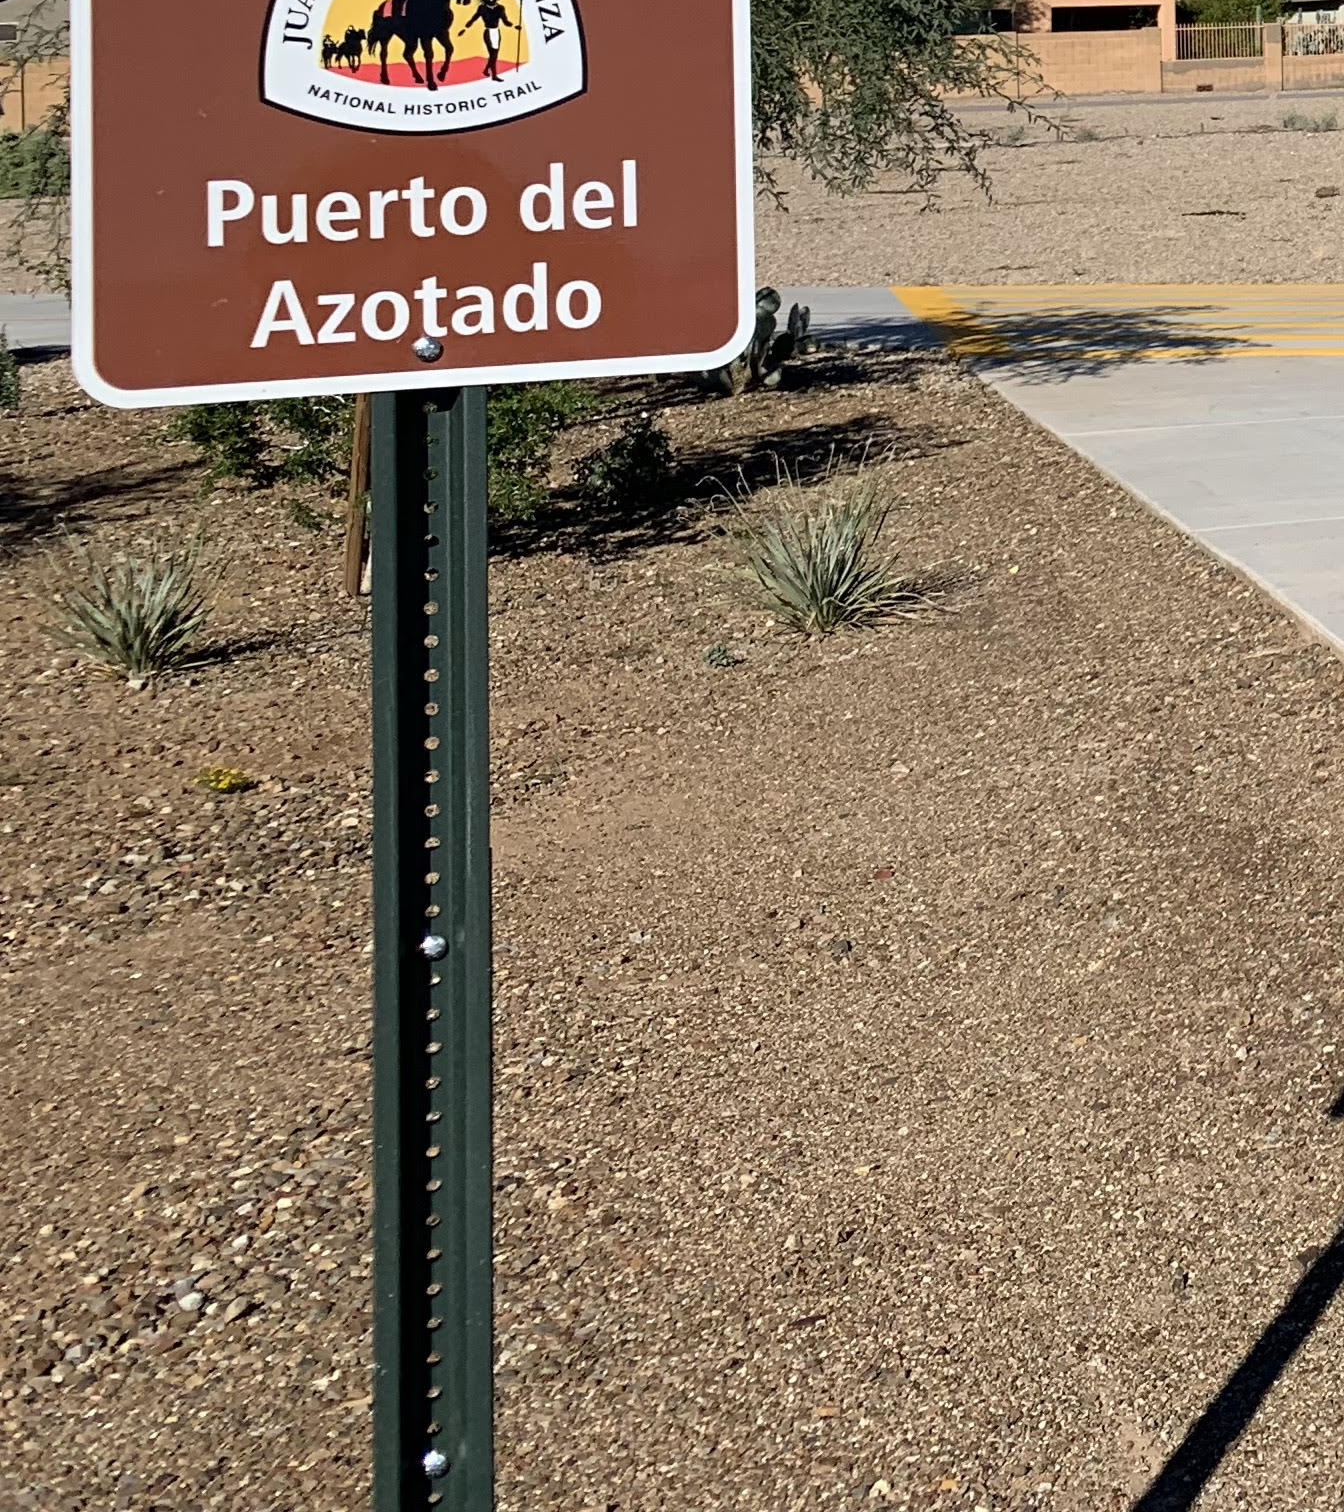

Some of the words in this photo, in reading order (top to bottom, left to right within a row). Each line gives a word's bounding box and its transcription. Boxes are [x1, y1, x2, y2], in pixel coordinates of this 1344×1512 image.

[307, 84, 397, 114] NATIONAL
[403, 96, 488, 115] HISTORIC
[492, 80, 542, 104] TRAIL
[207, 179, 489, 247] Puerto
[519, 160, 638, 232] del
[250, 261, 603, 348] Azotado
